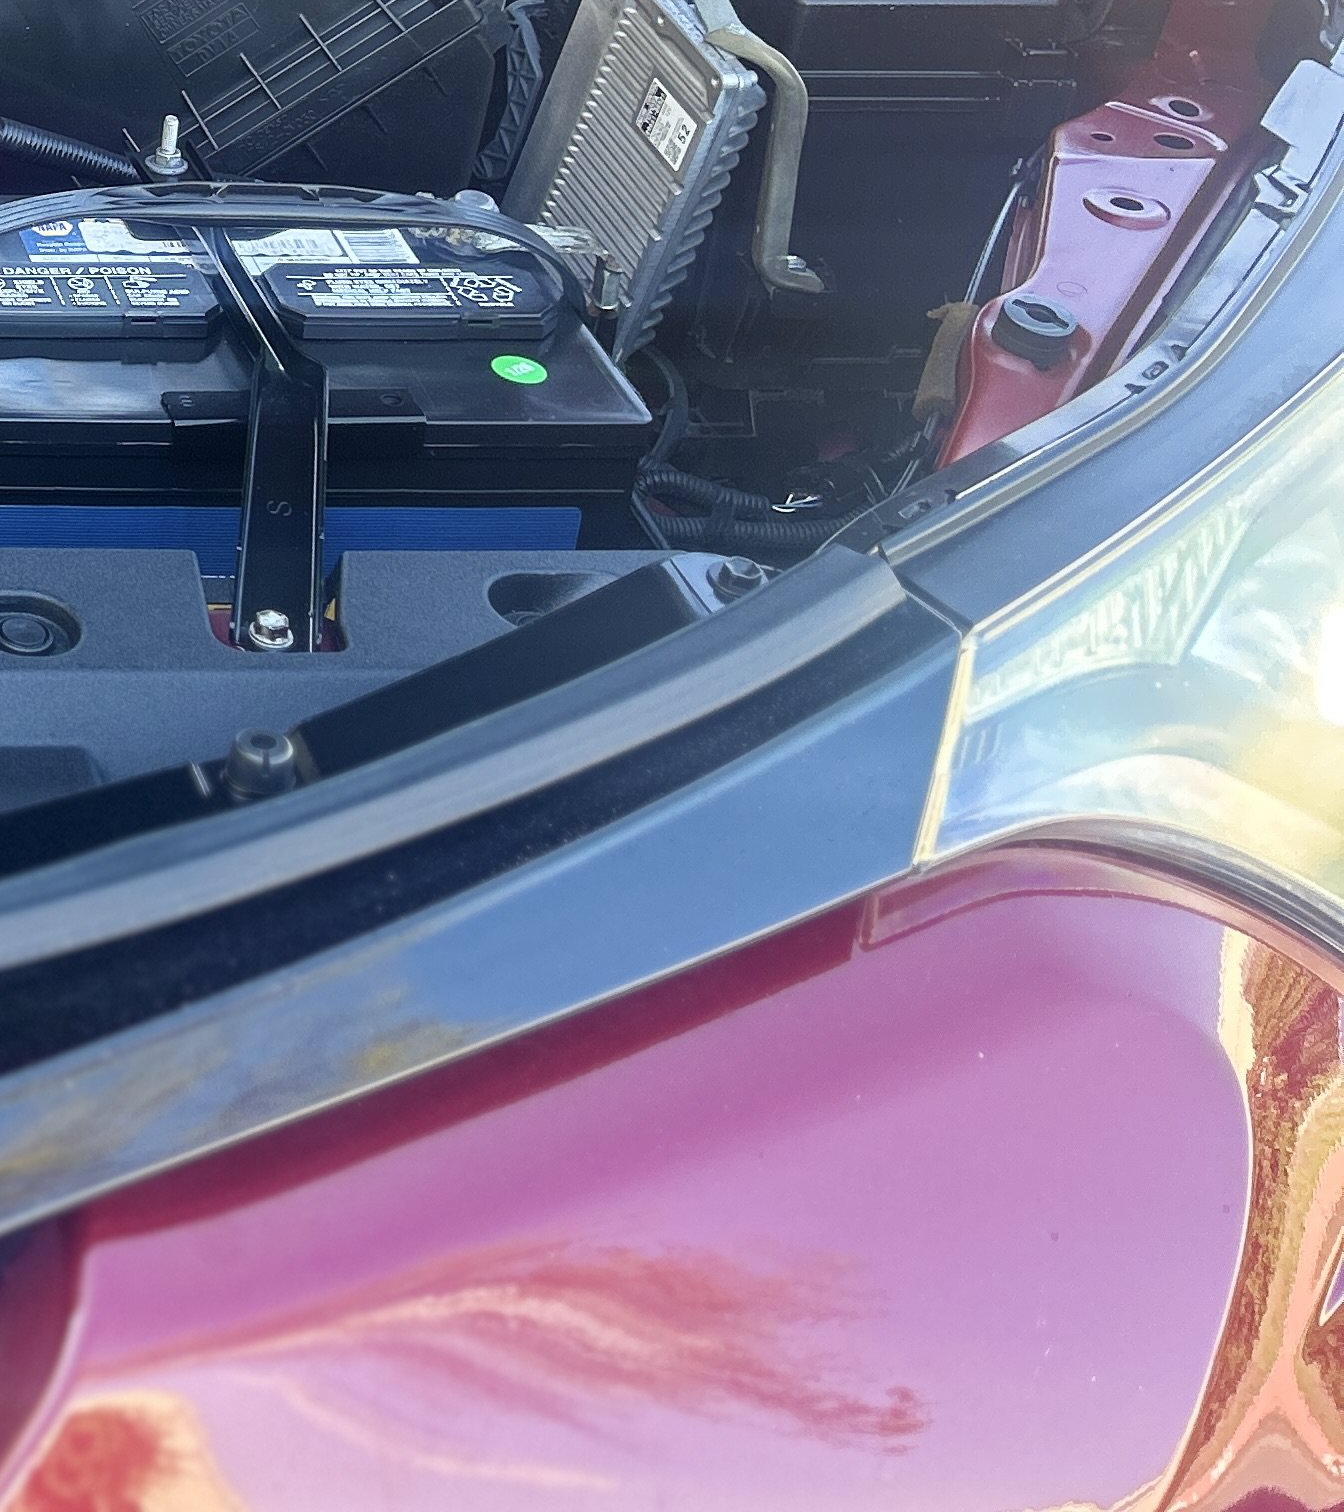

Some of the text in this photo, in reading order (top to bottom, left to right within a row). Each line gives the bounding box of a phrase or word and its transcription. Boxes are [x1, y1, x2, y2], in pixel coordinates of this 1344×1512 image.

[677, 124, 691, 145] 52
[2, 267, 72, 275] DANGER
[88, 266, 152, 275] POISON
